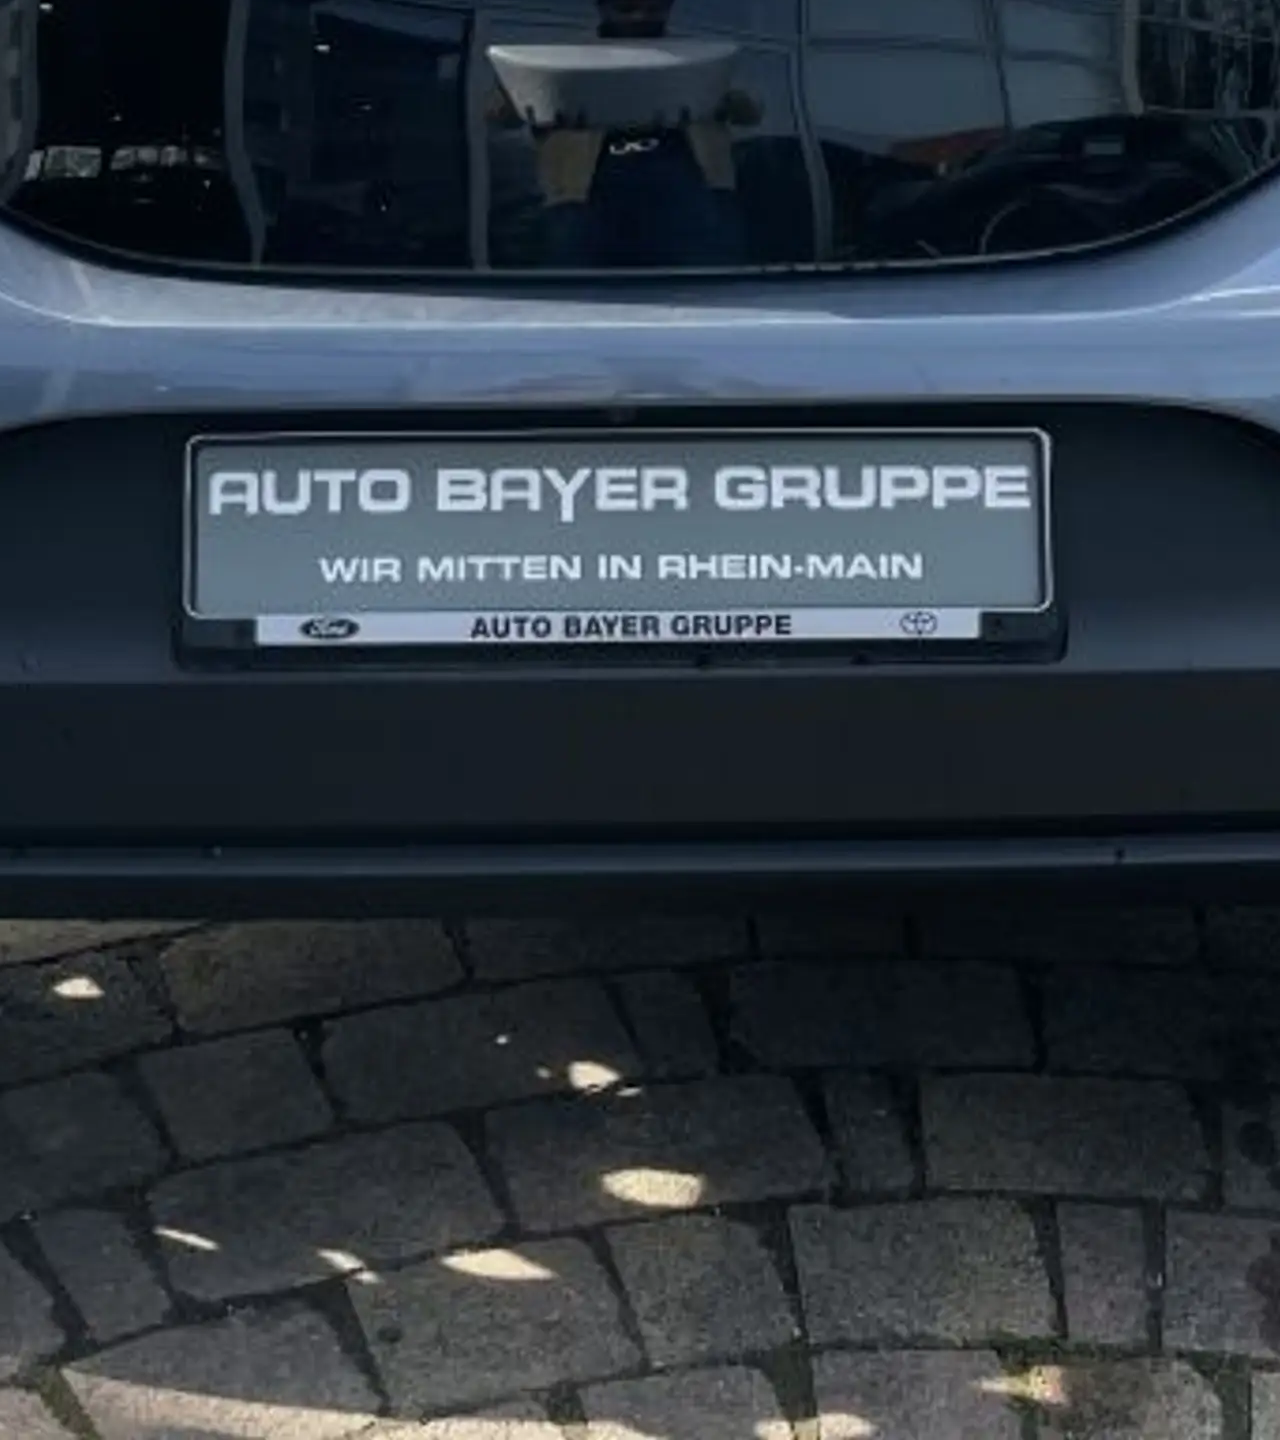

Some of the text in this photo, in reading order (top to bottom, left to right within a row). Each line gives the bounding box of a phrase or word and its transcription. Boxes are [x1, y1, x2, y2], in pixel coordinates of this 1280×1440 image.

[208, 464, 1032, 523] AUTO BAYER GRUPPE
[319, 554, 924, 583] WIR MITTEN IN RHEIN-MAIN
[470, 613, 793, 640] AUTO BAYER GRUPPE
